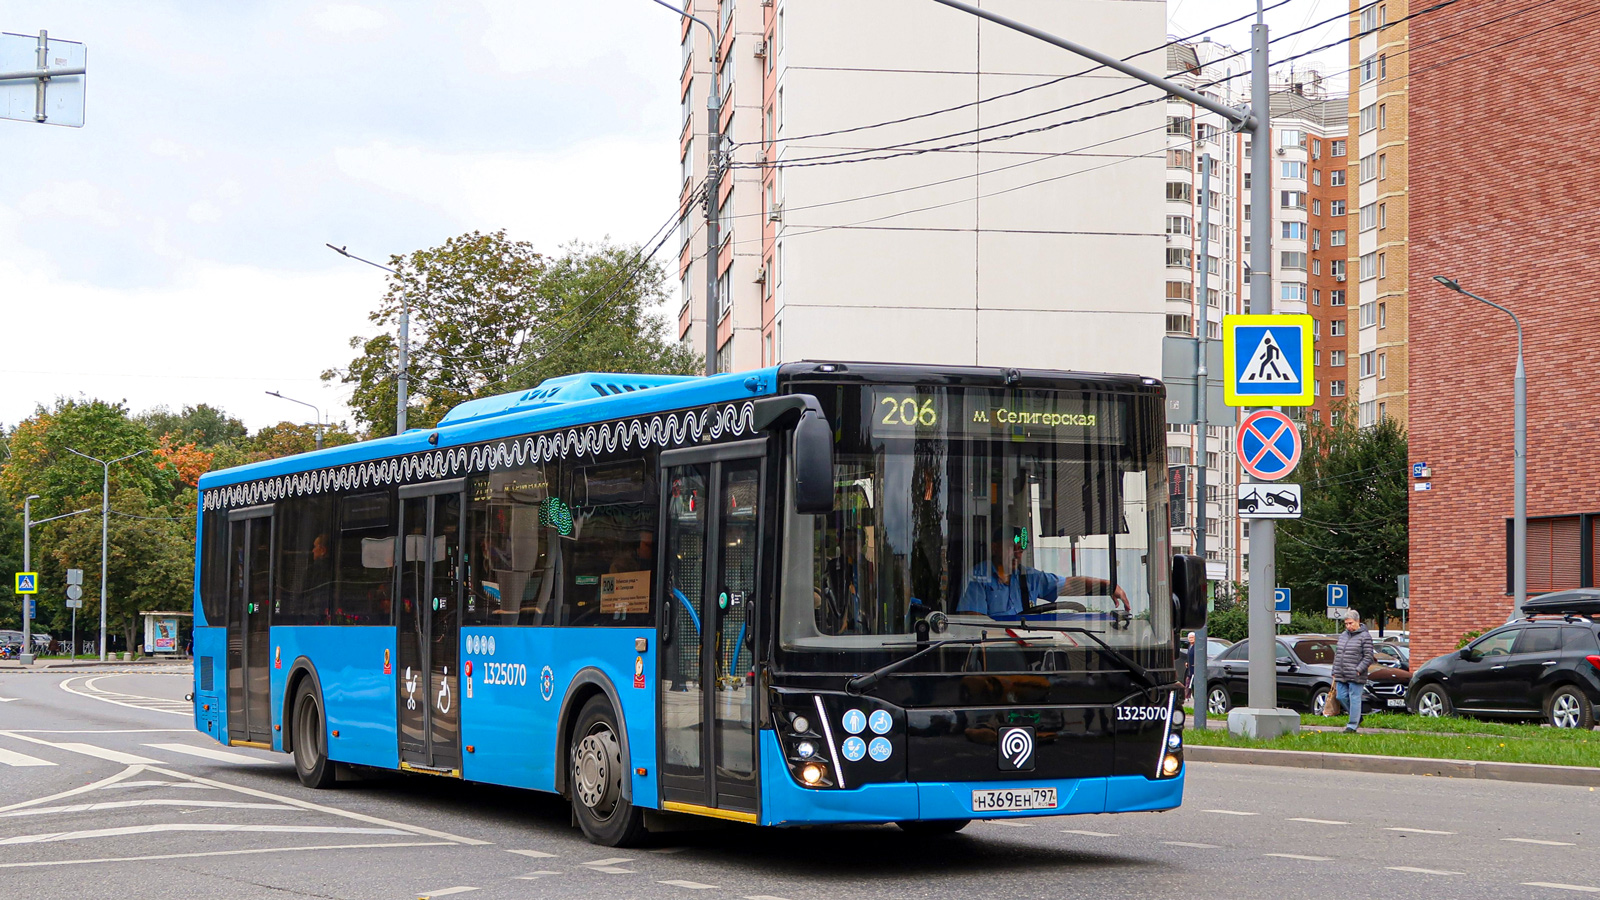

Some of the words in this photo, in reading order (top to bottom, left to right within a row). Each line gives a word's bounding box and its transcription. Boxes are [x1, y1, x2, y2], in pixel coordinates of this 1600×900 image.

[881, 397, 937, 426] 206
[996, 408, 1096, 427] Селигерская
[1332, 587, 1344, 605] P
[483, 662, 527, 687] 1325070
[1116, 706, 1167, 720] 1325070
[978, 792, 1031, 808] Н369ЕН
[1033, 790, 1054, 802] 797
